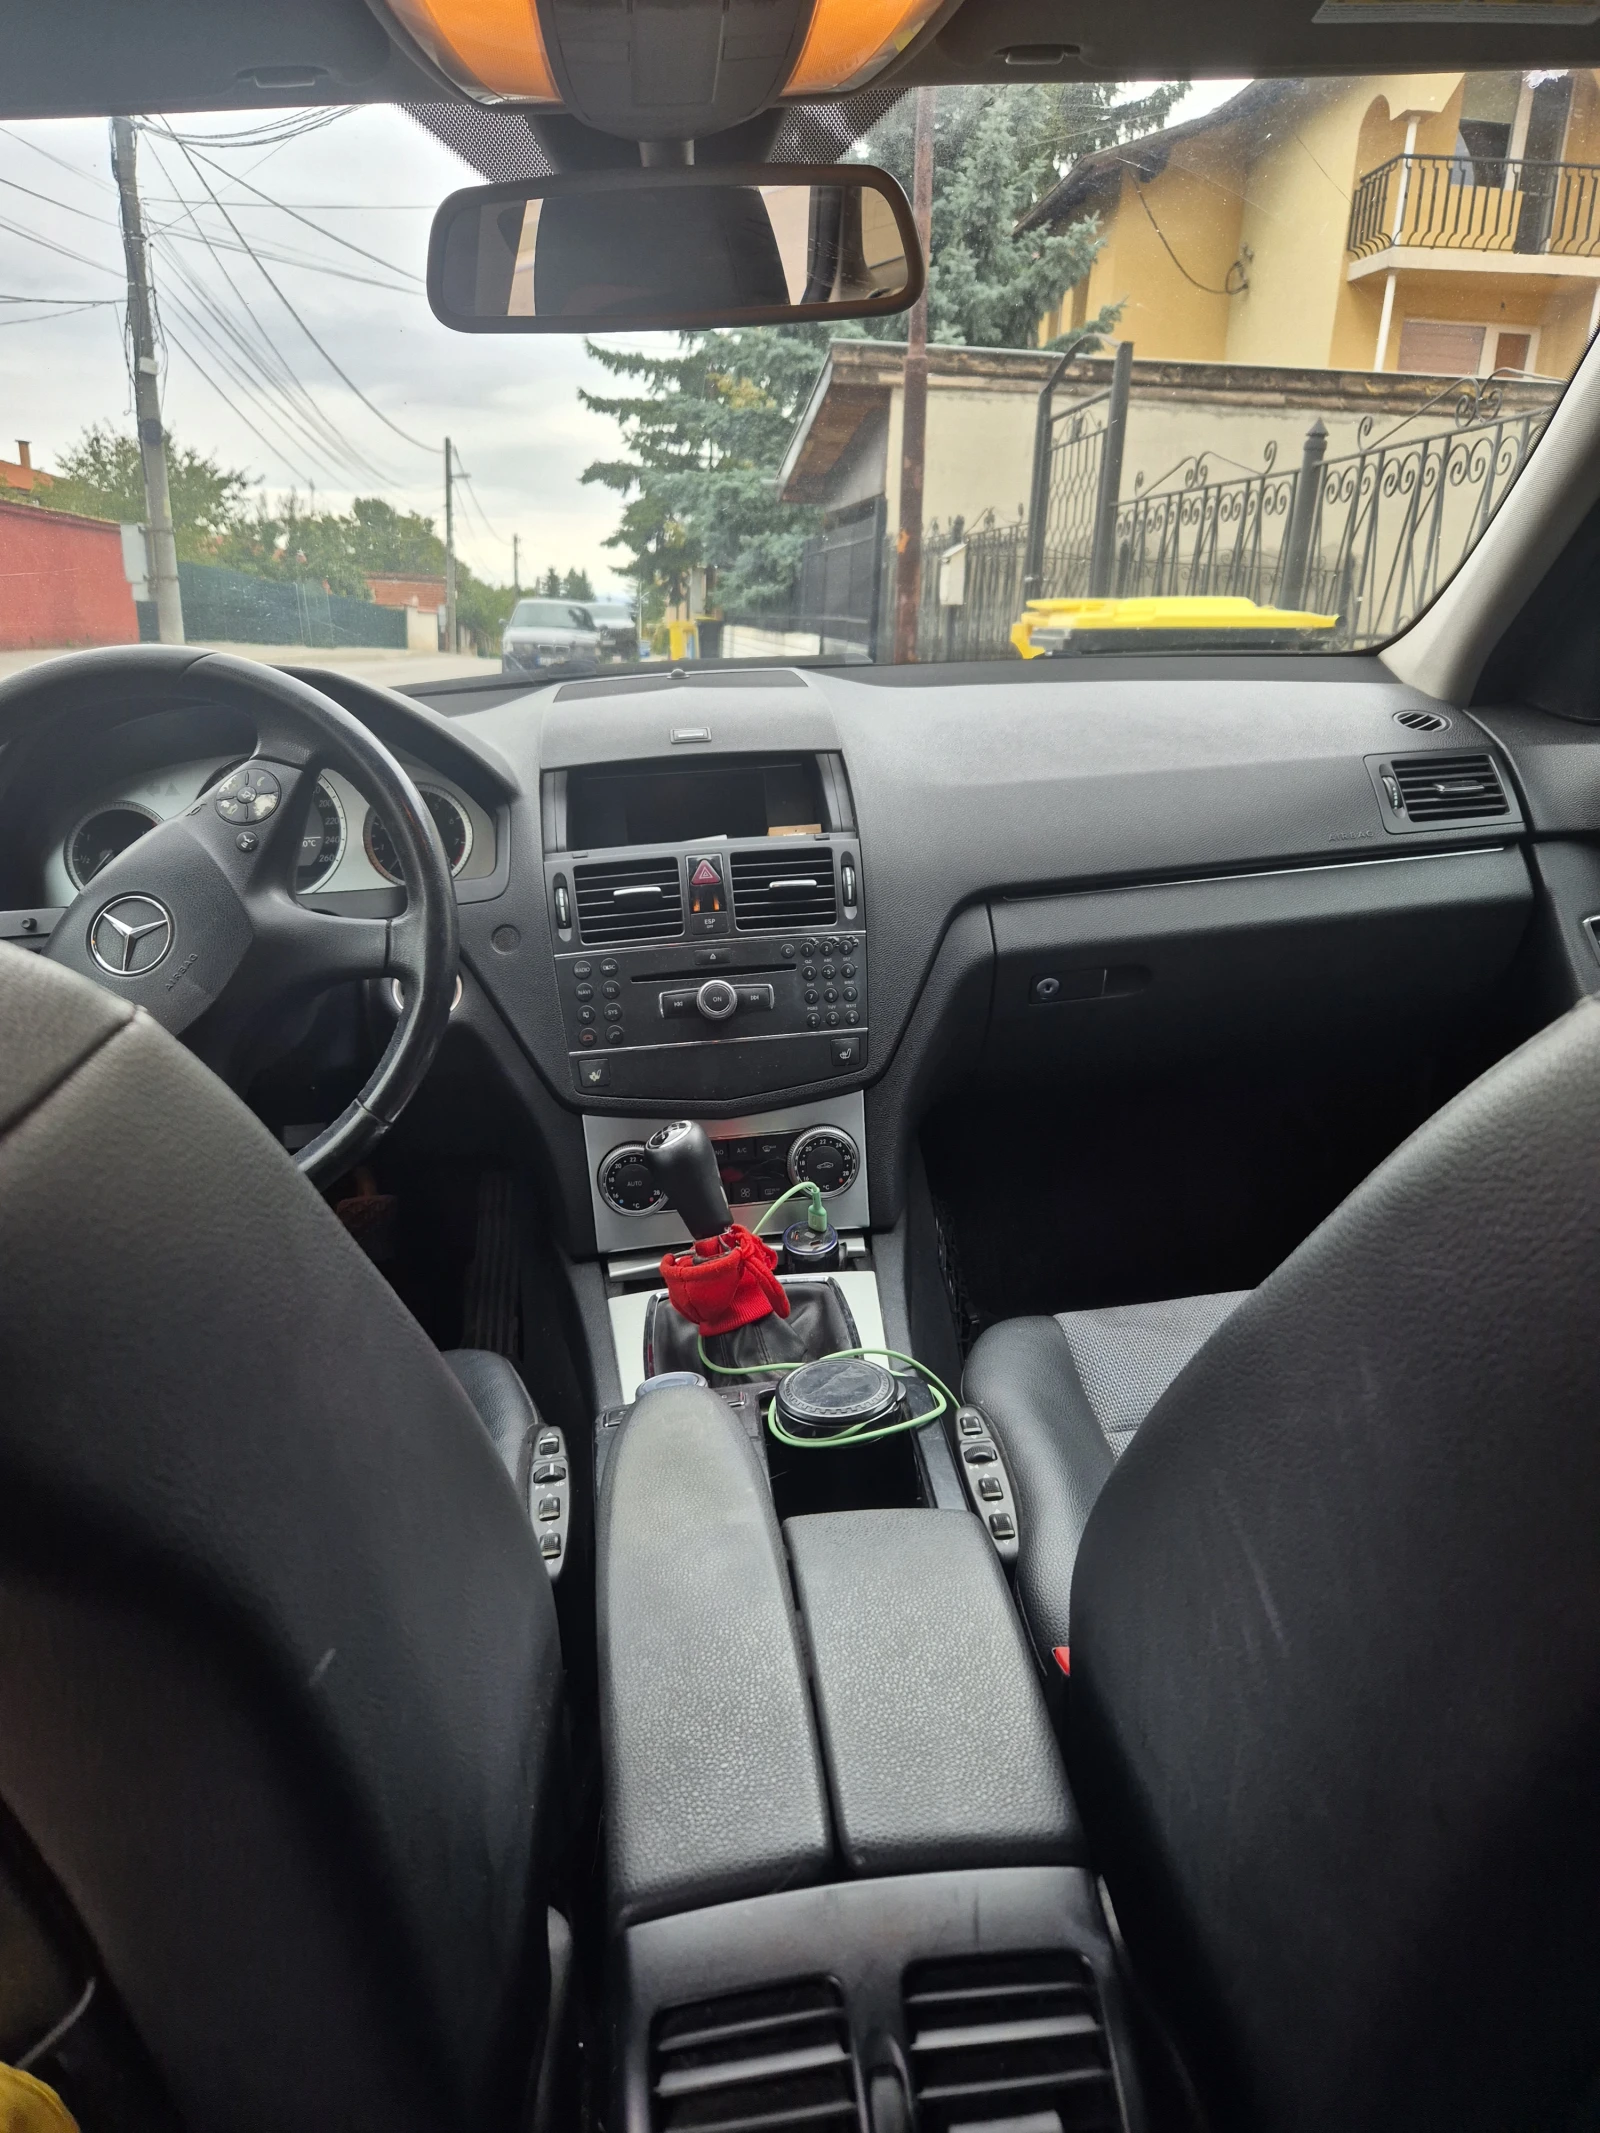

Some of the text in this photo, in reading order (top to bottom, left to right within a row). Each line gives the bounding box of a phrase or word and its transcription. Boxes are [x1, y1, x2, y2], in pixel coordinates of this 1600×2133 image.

[319, 800, 333, 808] 200
[325, 817, 339, 825] 220
[325, 836, 340, 844] 240
[1328, 830, 1374, 842] AIRBAG
[319, 854, 334, 862] 260
[165, 953, 198, 991] AIRBAG
